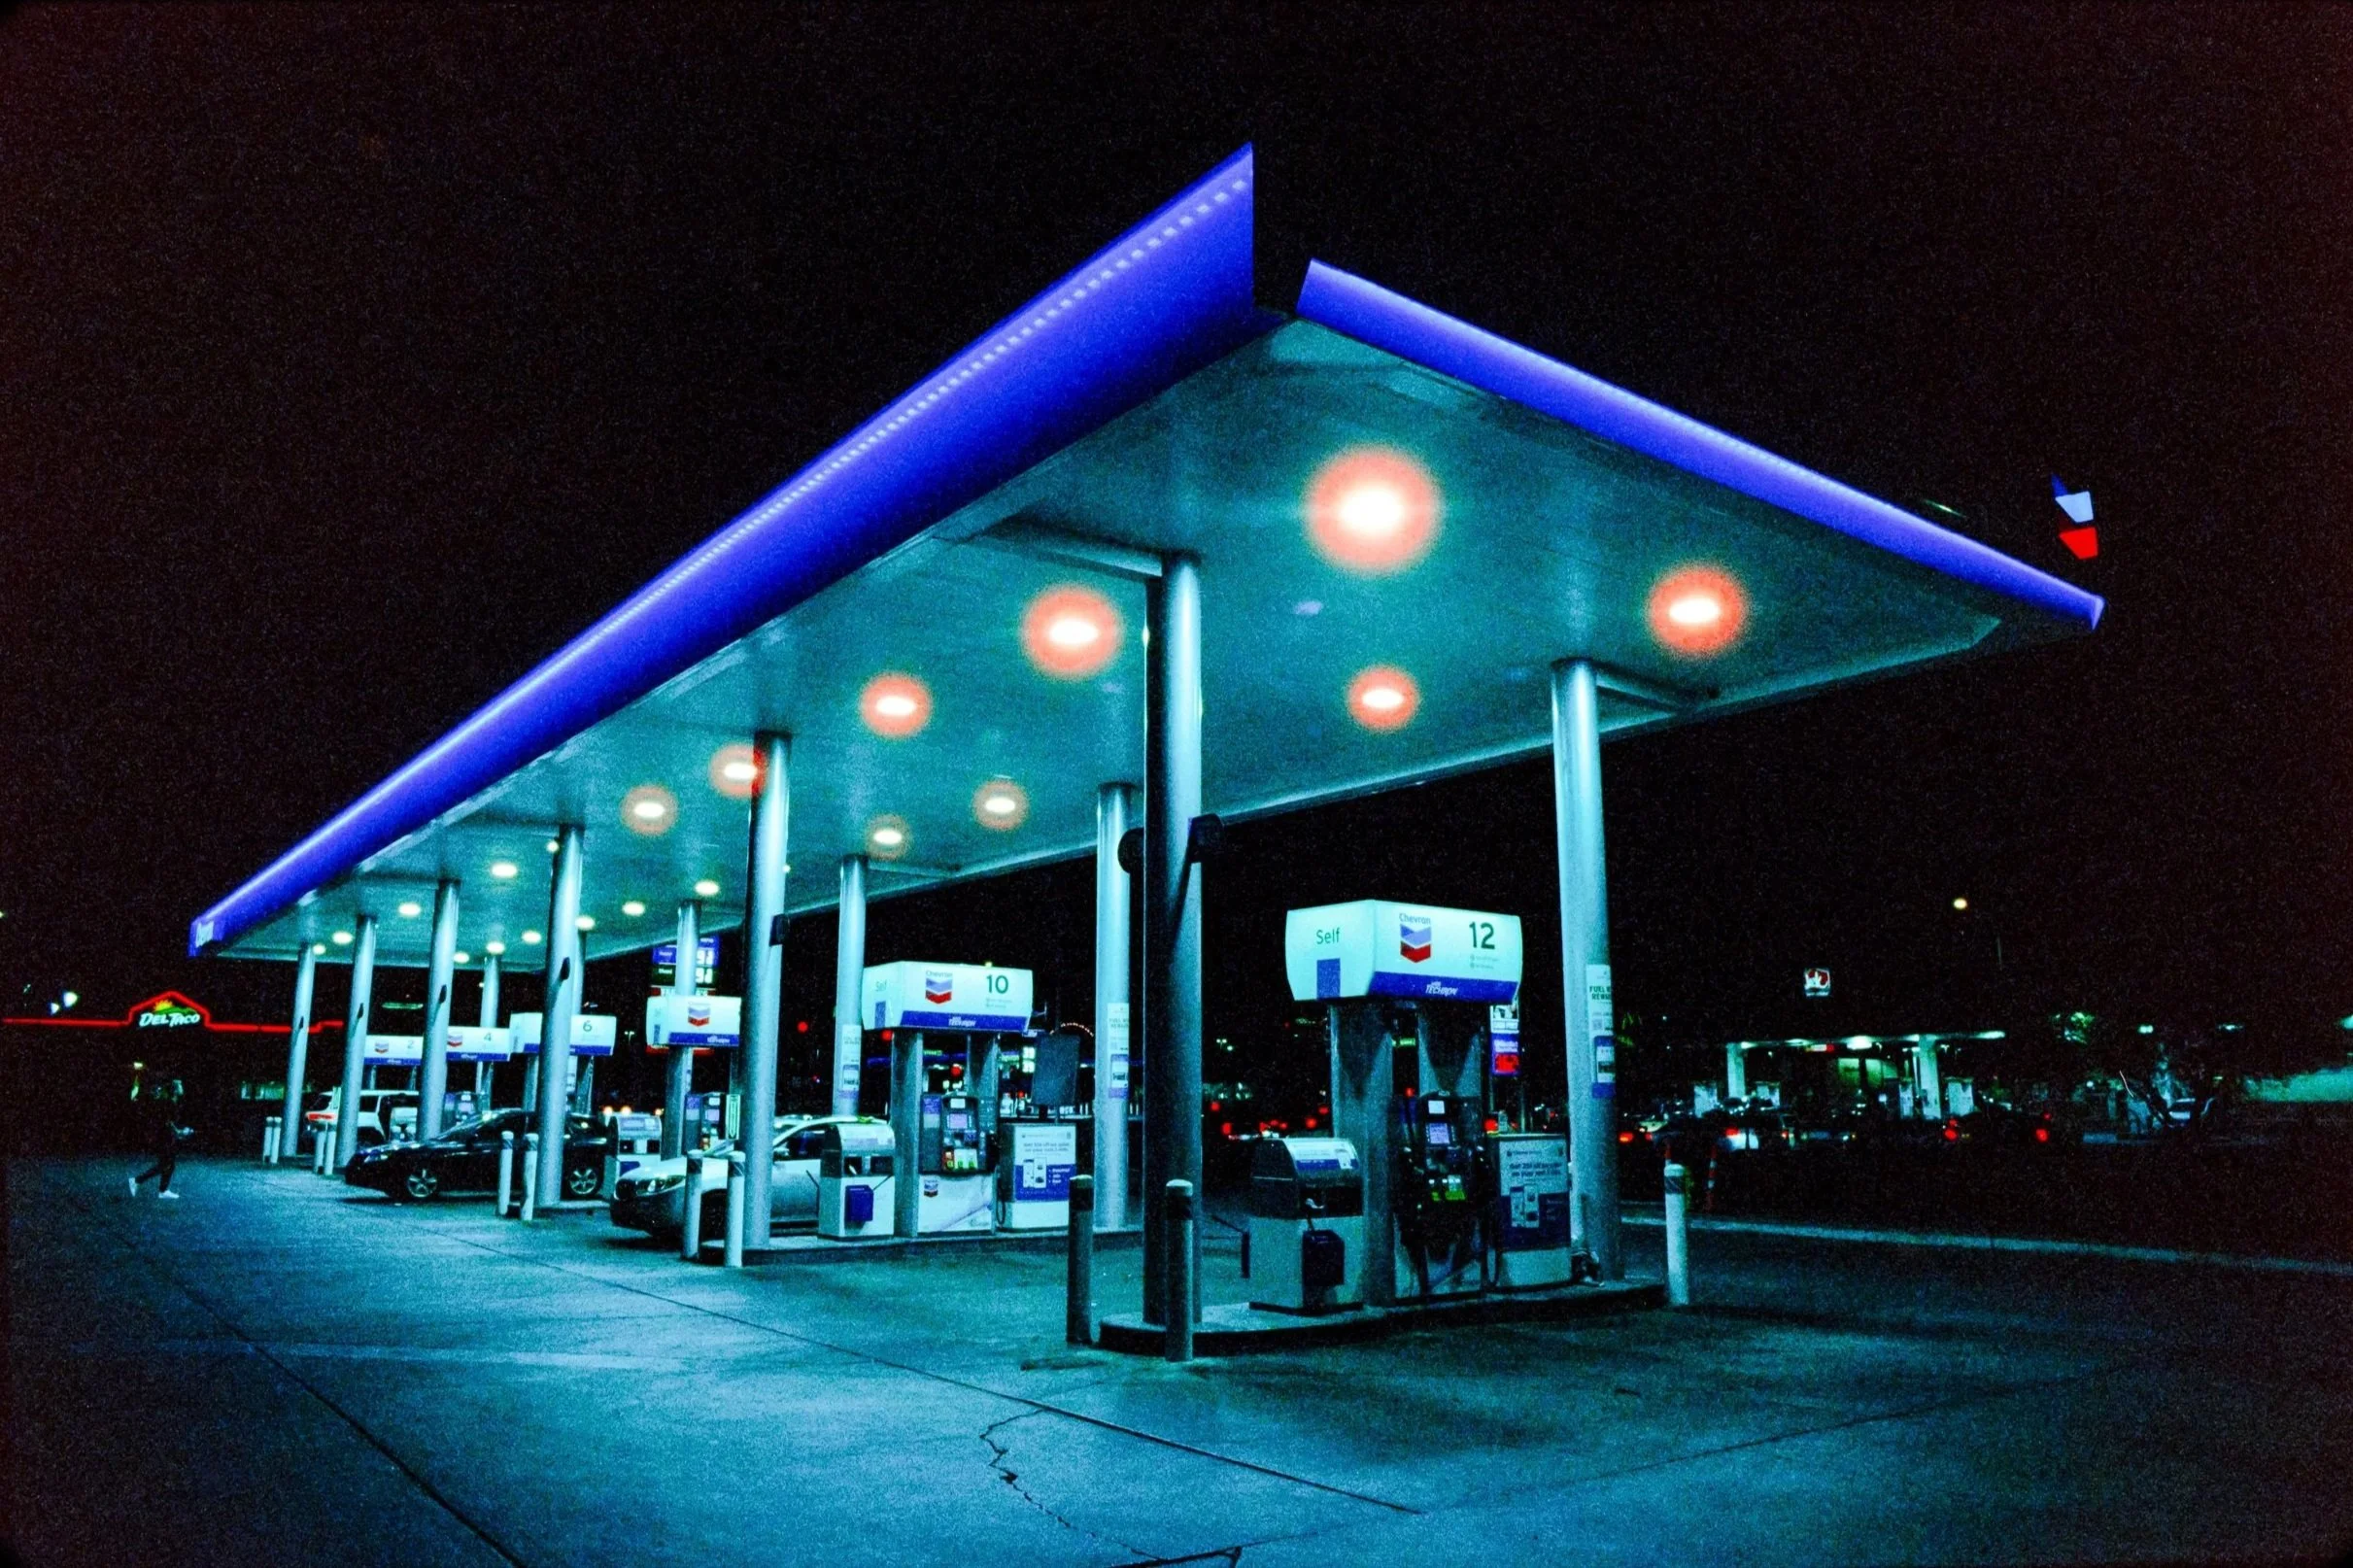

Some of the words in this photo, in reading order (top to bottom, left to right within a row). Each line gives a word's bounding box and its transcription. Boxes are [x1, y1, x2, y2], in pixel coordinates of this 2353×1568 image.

[1399, 912, 1431, 925] Chevron
[1316, 927, 1341, 945] Self
[1469, 921, 1496, 950] 12
[986, 974, 1009, 994] 10
[139, 1012, 168, 1027] DEL
[168, 1012, 201, 1027] TACO
[582, 1020, 593, 1032] 6
[483, 1032, 493, 1042] 4
[407, 1040, 415, 1049] 2
